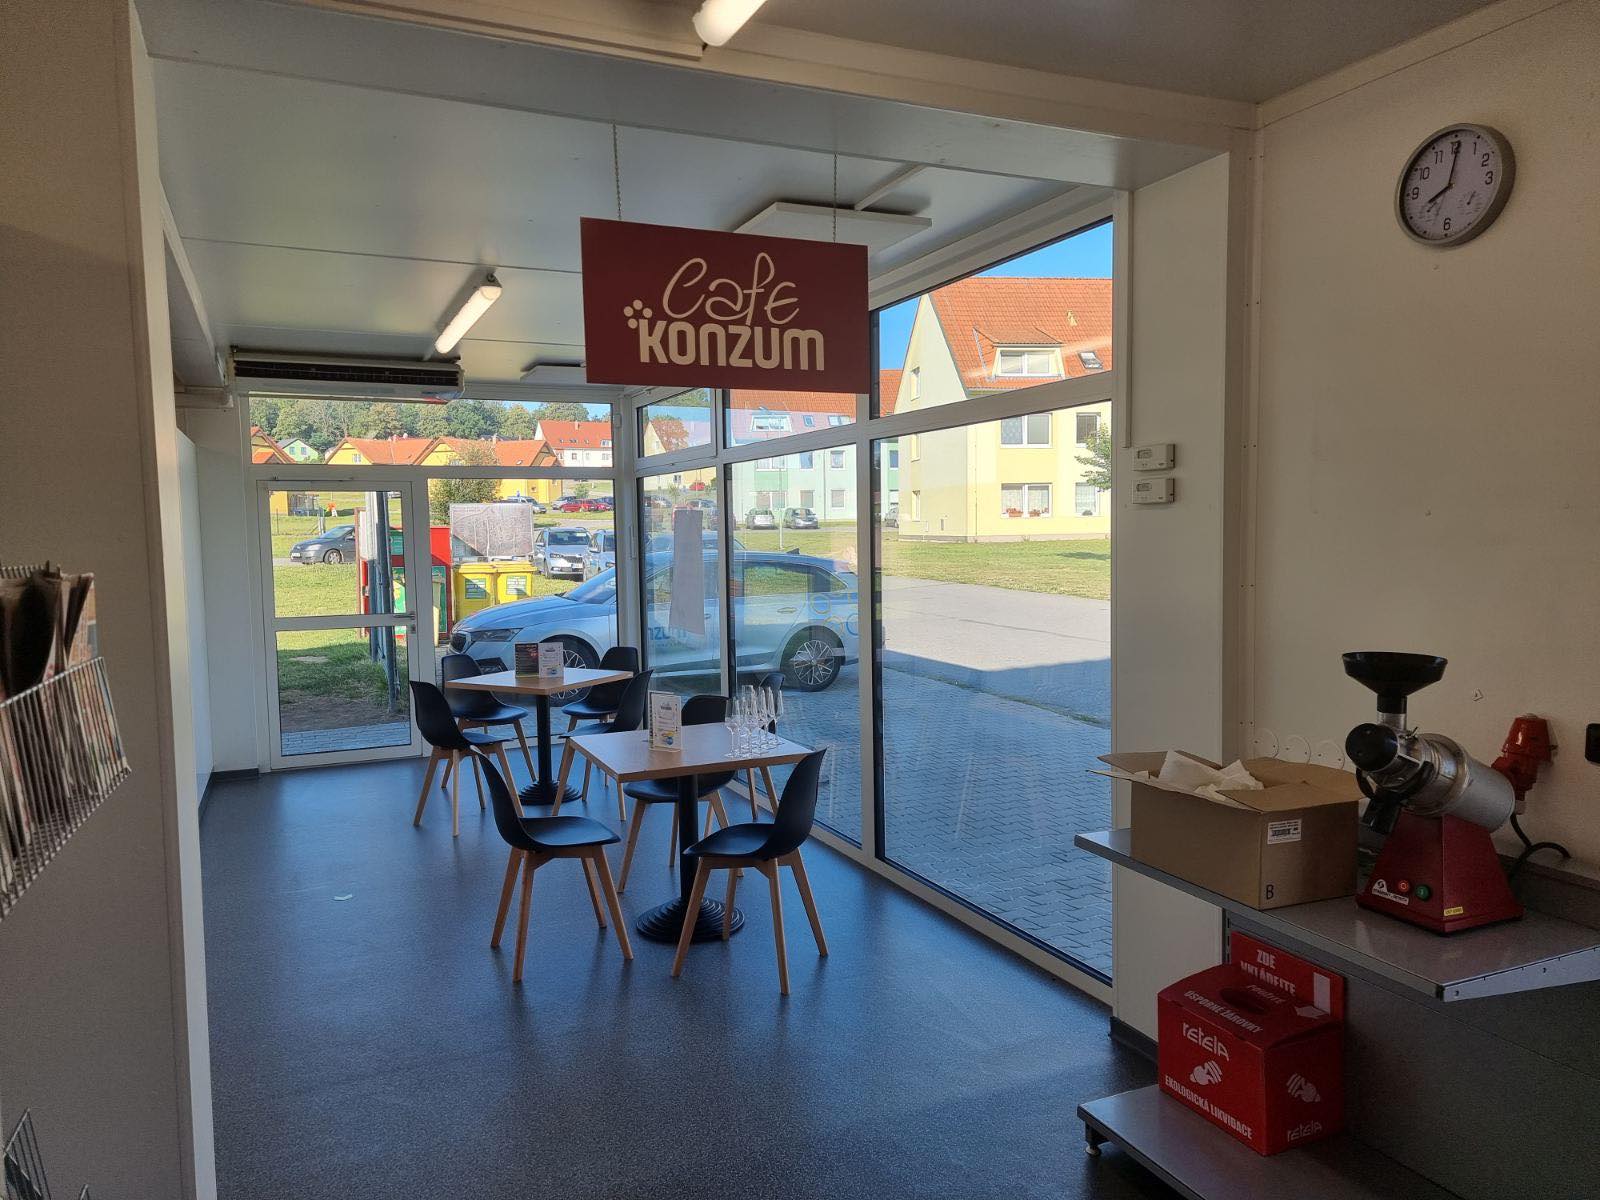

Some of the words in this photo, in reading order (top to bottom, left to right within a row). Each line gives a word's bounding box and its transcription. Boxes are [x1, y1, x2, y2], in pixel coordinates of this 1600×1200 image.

[1472, 142, 1478, 155] 1
[1434, 150, 1444, 165] 11
[1481, 152, 1490, 167] 2
[1419, 166, 1430, 181] 10
[1486, 171, 1493, 185] 3
[1412, 187, 1420, 200] 9
[1444, 218, 1452, 231] 6
[1265, 884, 1274, 900] B
[1256, 949, 1276, 970] ZDE
[1164, 1074, 1210, 1112] EKOLOGICKÁ
[1210, 1104, 1254, 1140] LIKVIDACE
